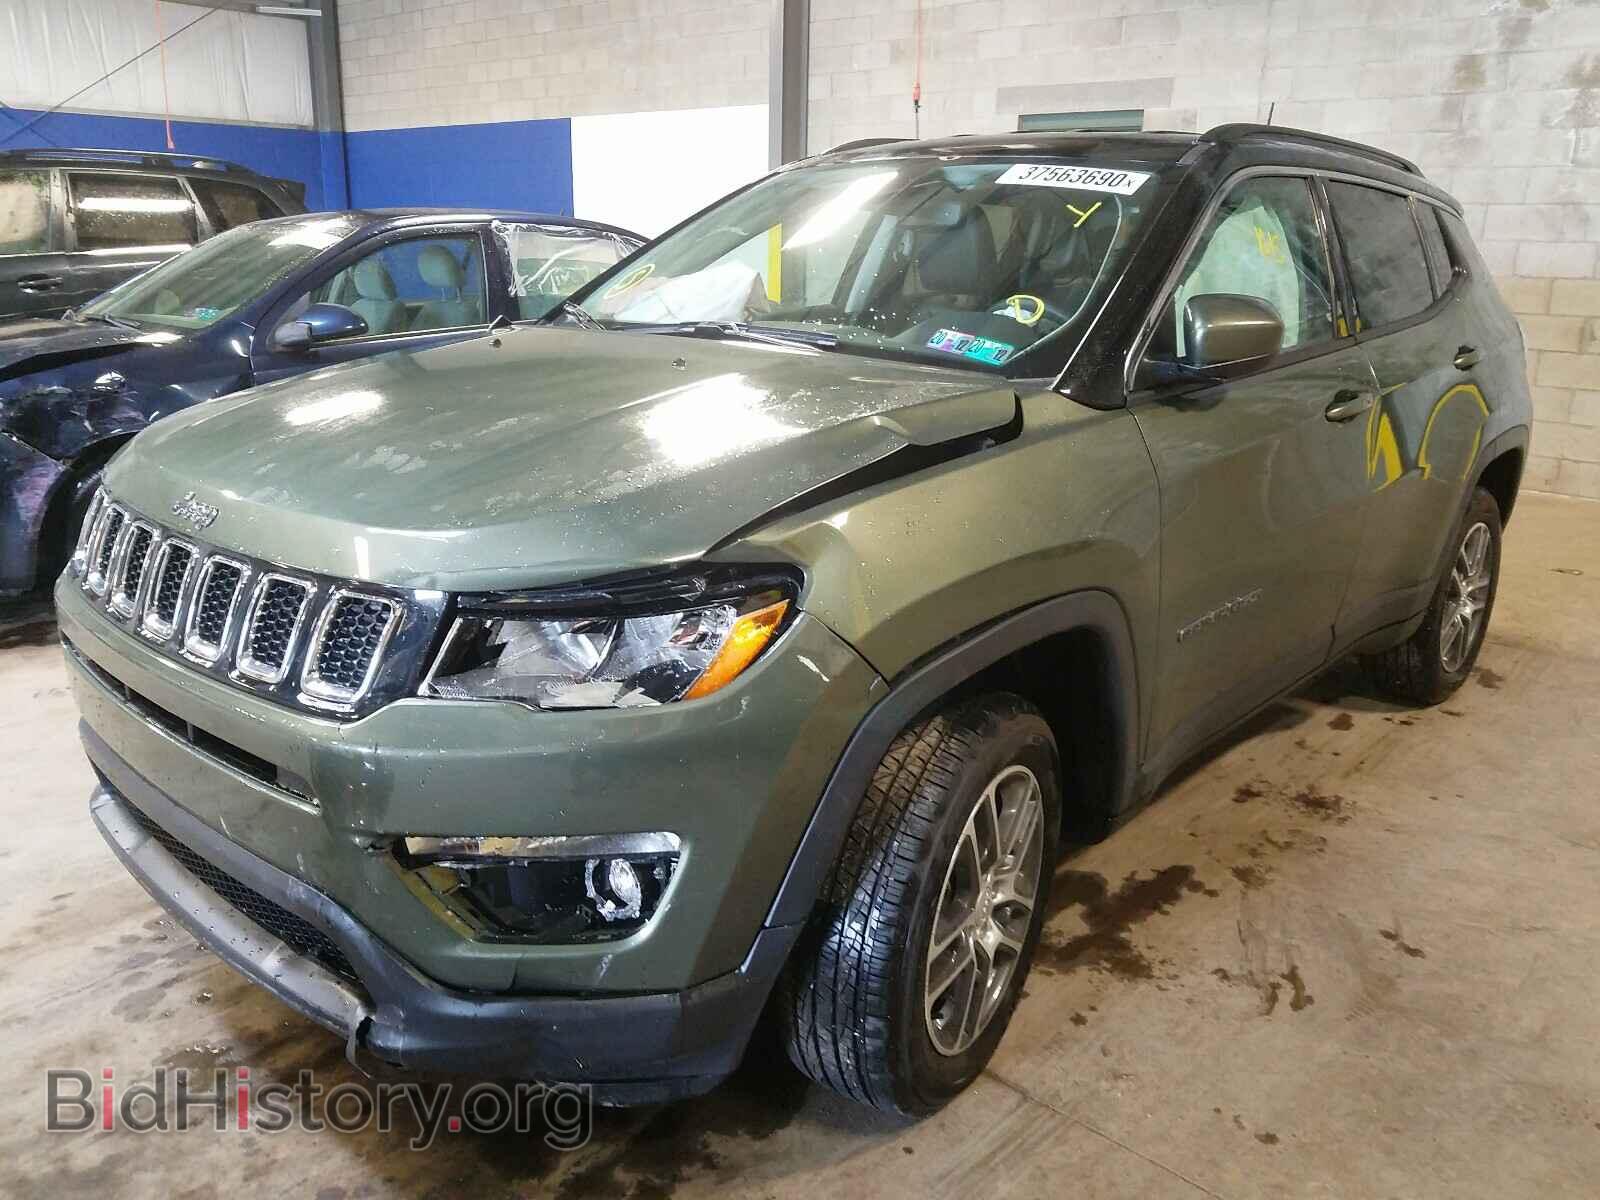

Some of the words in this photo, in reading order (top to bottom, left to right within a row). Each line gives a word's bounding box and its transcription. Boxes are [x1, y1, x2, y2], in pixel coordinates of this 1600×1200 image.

[930, 330, 947, 345] 20
[968, 339, 986, 353] 20
[993, 349, 1008, 361] 12
